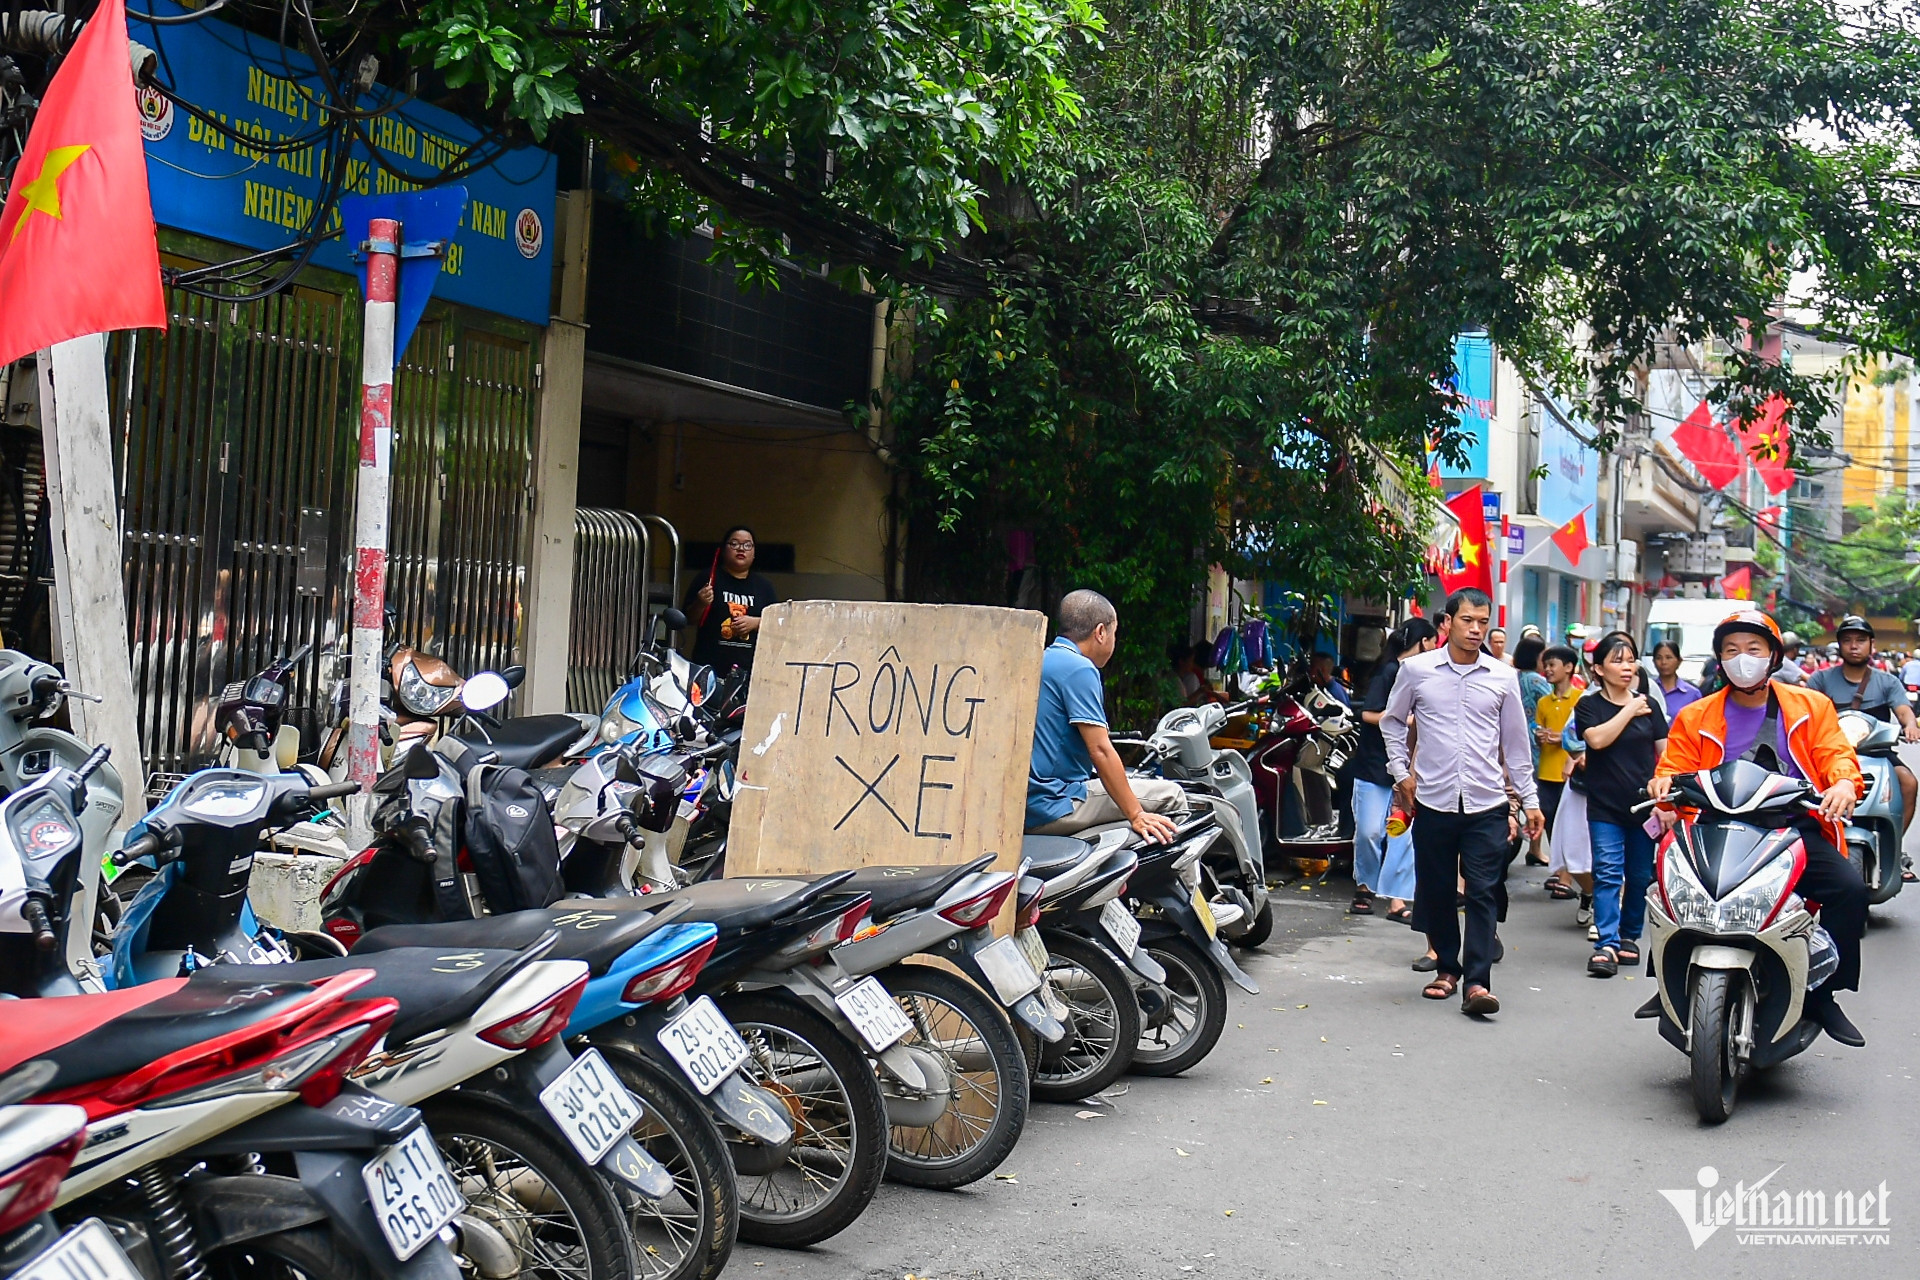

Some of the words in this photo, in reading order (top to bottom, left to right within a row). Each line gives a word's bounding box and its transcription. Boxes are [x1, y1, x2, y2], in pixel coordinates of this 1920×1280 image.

[247, 66, 313, 123] NHIỆT
[188, 104, 228, 153] ĐẠI
[471, 200, 507, 240] NAM
[243, 180, 313, 235] NHIỆM
[723, 591, 755, 607] TEDDY
[785, 645, 986, 739] TRÔNG
[833, 753, 956, 840] XE
[689, 1030, 743, 1086] 802.83
[578, 1092, 631, 1151] 0284
[376, 1138, 432, 1207] 29-T1
[387, 1173, 456, 1250] 056.00
